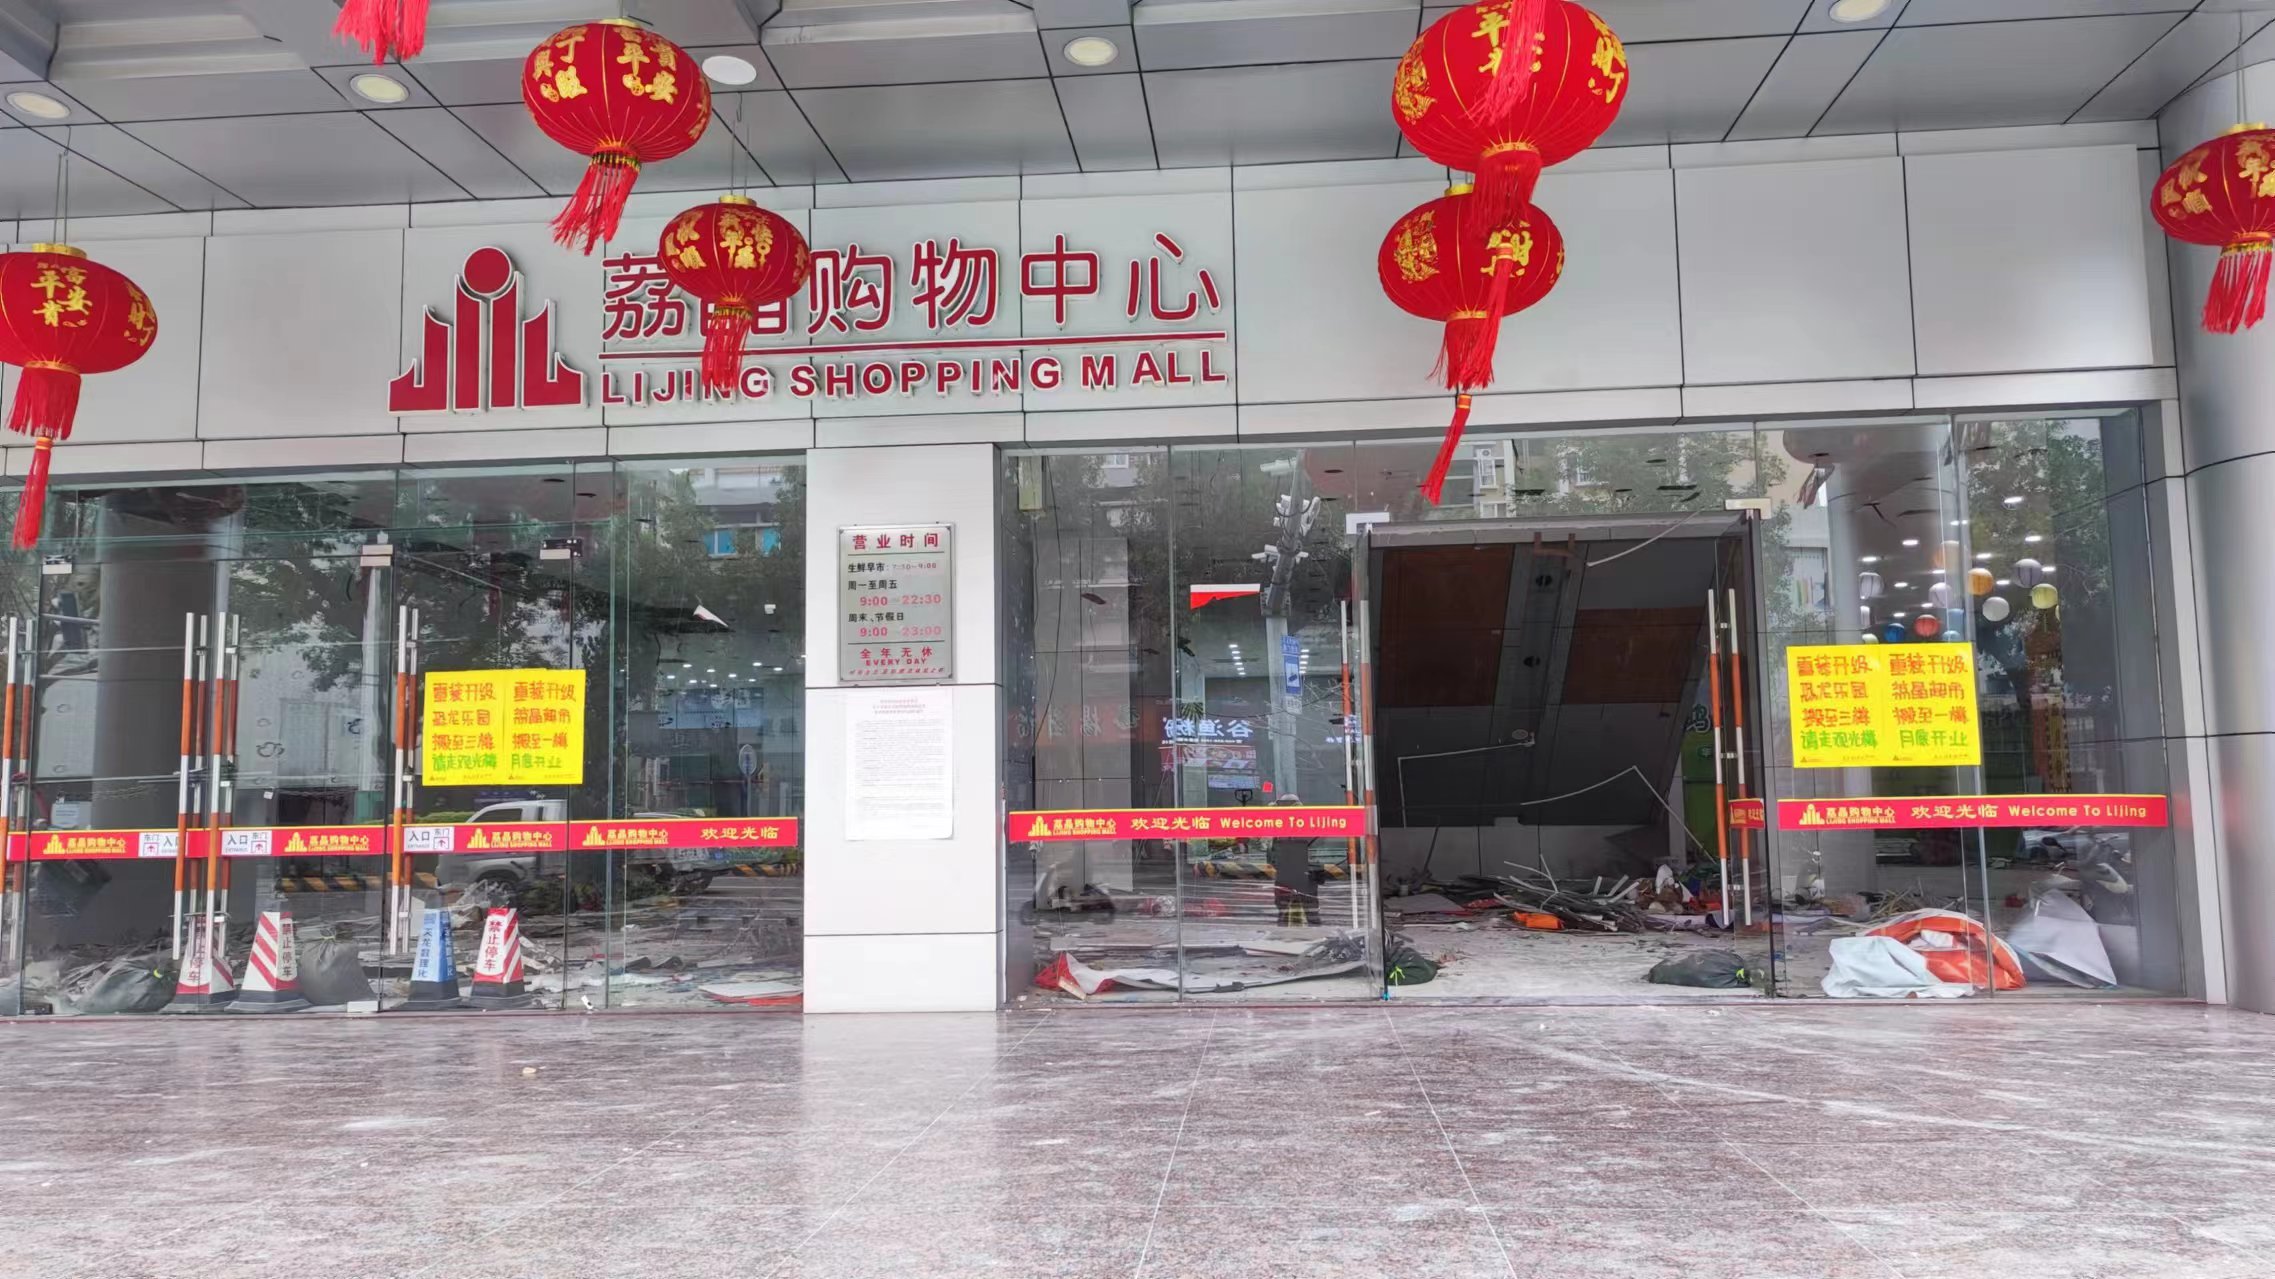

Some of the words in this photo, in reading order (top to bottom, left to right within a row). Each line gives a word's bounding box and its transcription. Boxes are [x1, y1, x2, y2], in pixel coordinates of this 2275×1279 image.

[602, 233, 1221, 341] 荔购物中心
[790, 355, 1061, 398] SHOPPING
[1080, 350, 1227, 391] MALL
[852, 532, 939, 551] 营业时间
[847, 579, 898, 590] 周一至周五
[847, 612, 904, 623] 周末、节假日
[860, 646, 933, 659] 全年无休
[865, 658, 901, 666] EVERY
[1911, 805, 1999, 819] 欢迎光临
[2008, 805, 2078, 818] Welcome
[2083, 805, 2100, 817] To
[1130, 816, 1211, 831] 欢迎光临
[1220, 816, 1284, 829] Welcome
[1289, 816, 1305, 828] To
[227, 834, 248, 846] 入口
[409, 831, 430, 842] 入口
[700, 826, 780, 841] 欢迎光临
[281, 923, 293, 977] 禁止停车
[483, 920, 503, 972] 禁止停车
